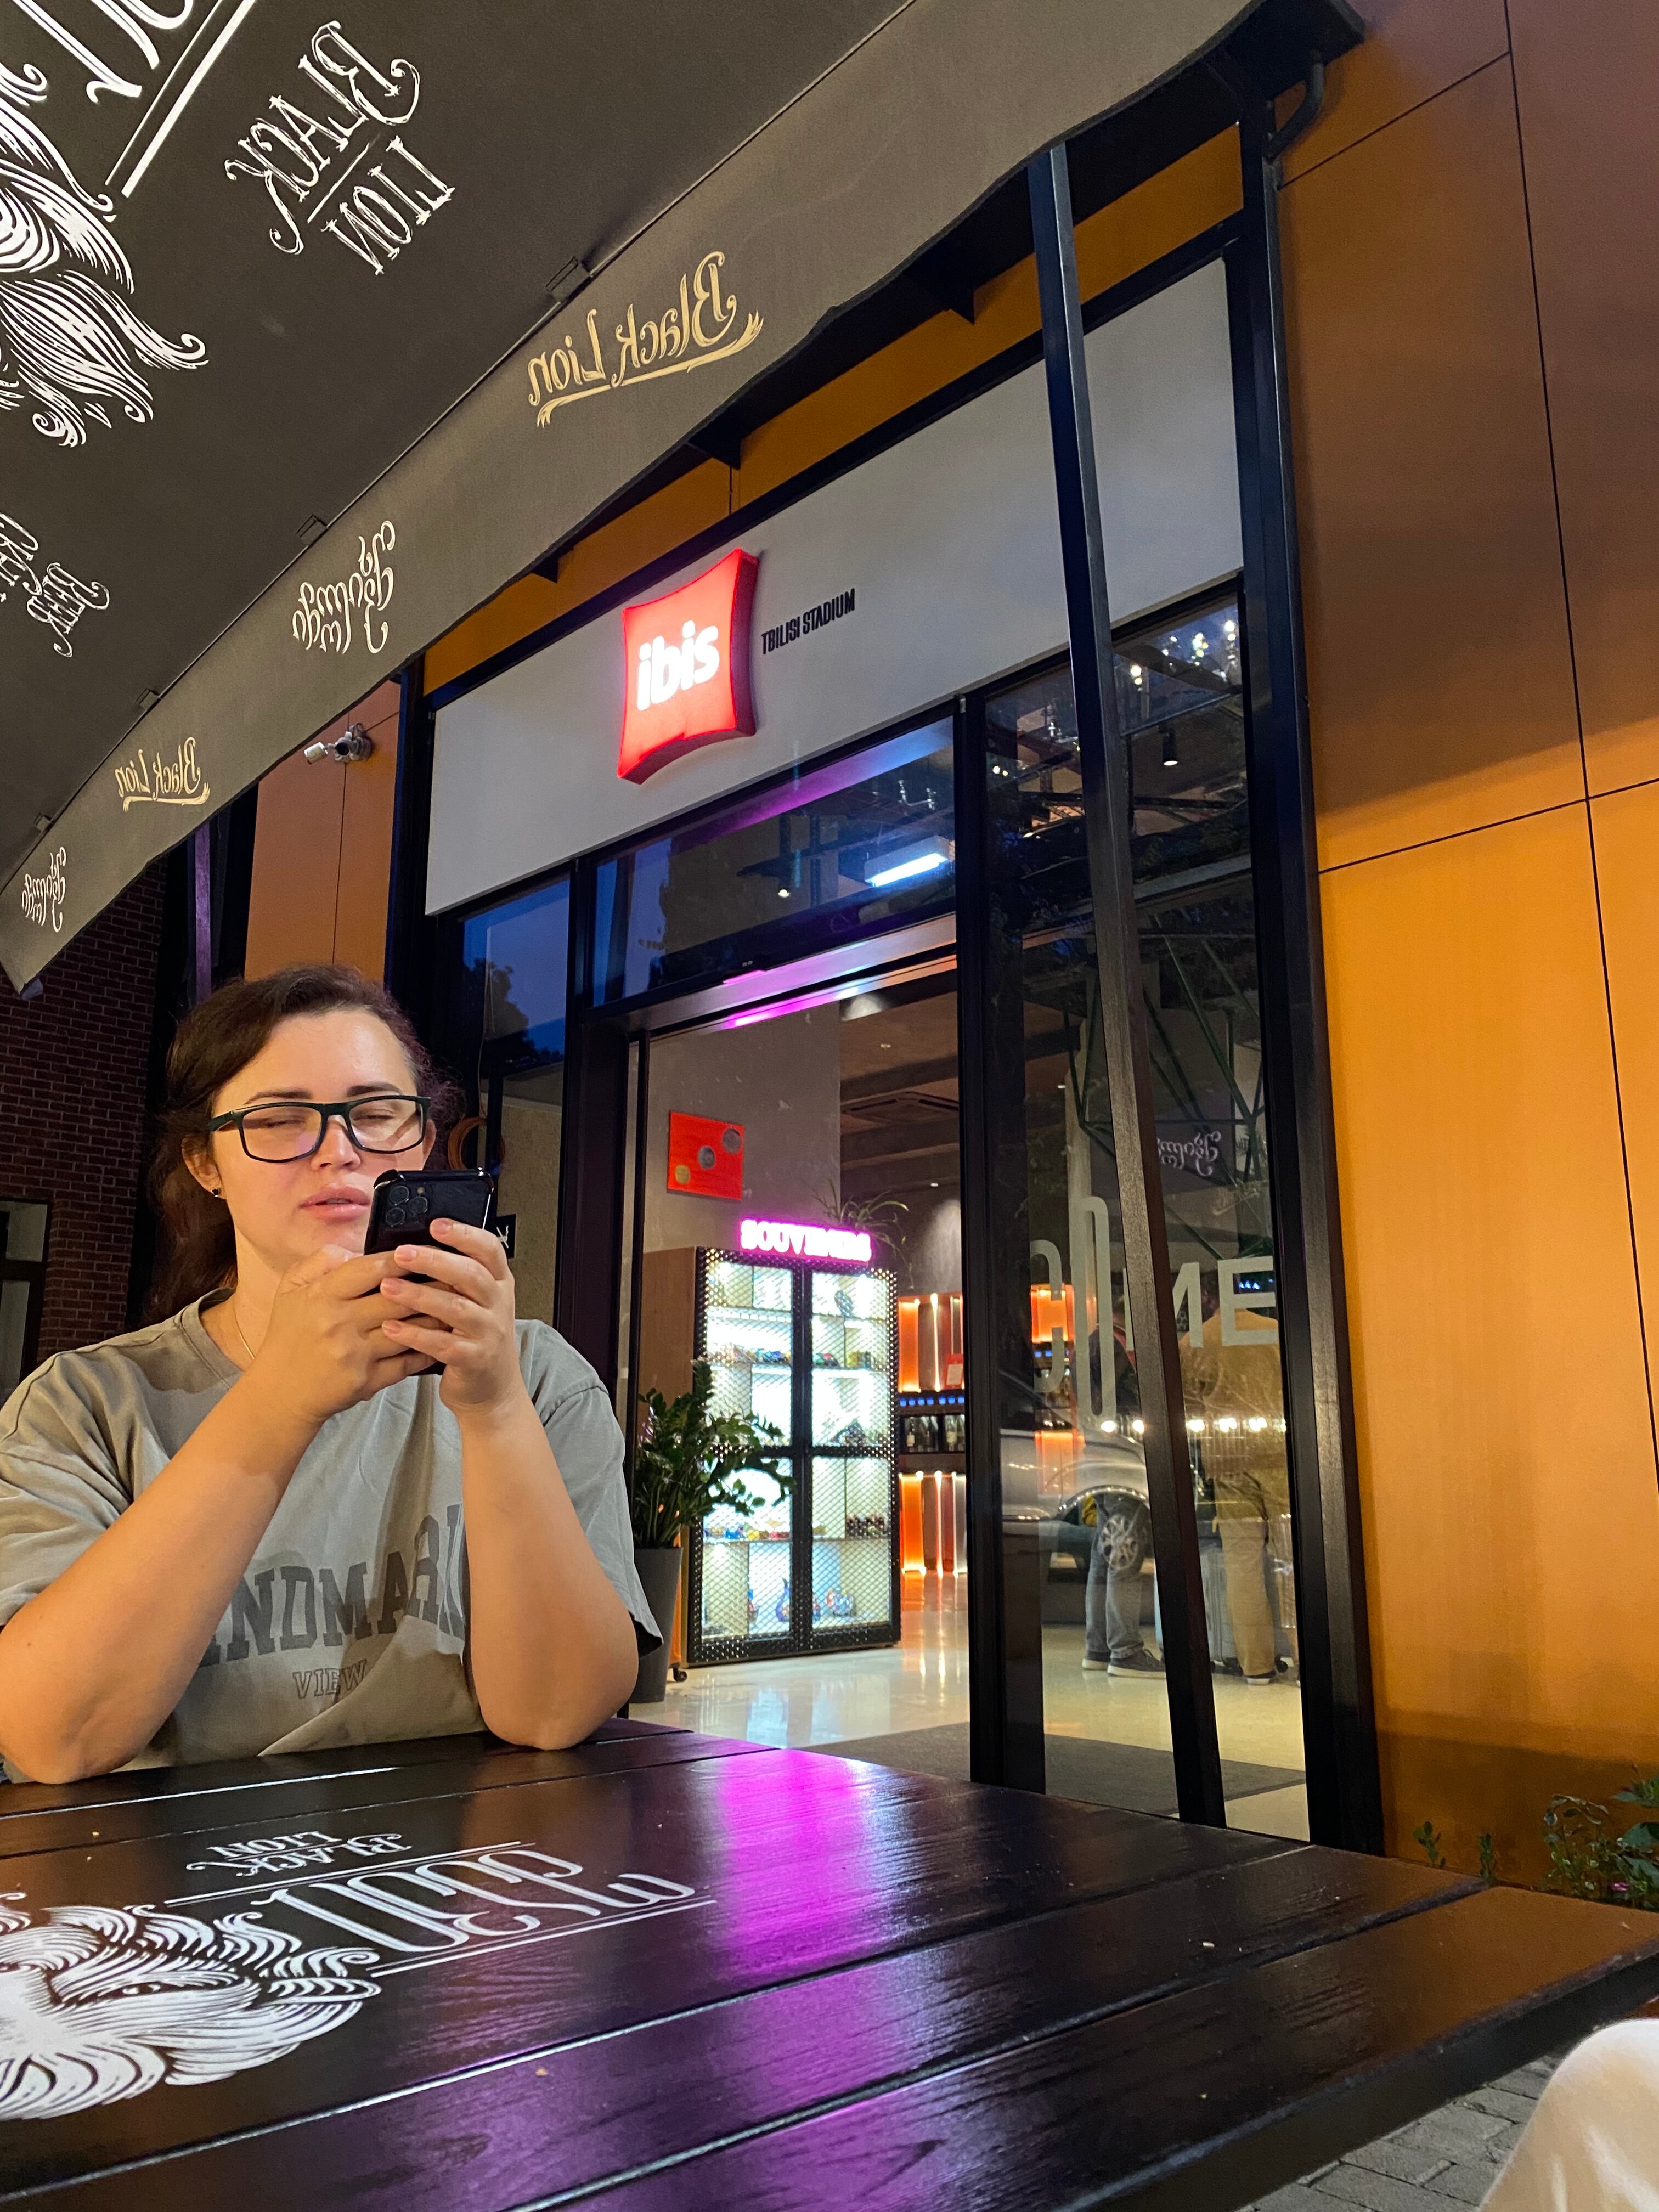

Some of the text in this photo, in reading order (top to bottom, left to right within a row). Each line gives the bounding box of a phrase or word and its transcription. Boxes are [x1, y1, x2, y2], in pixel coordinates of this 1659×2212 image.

[761, 588, 856, 655] TBILISI STADIUM
[636, 619, 720, 712] ibis
[186, 1833, 413, 1877] BLACK
[206, 1831, 342, 1858] LION
